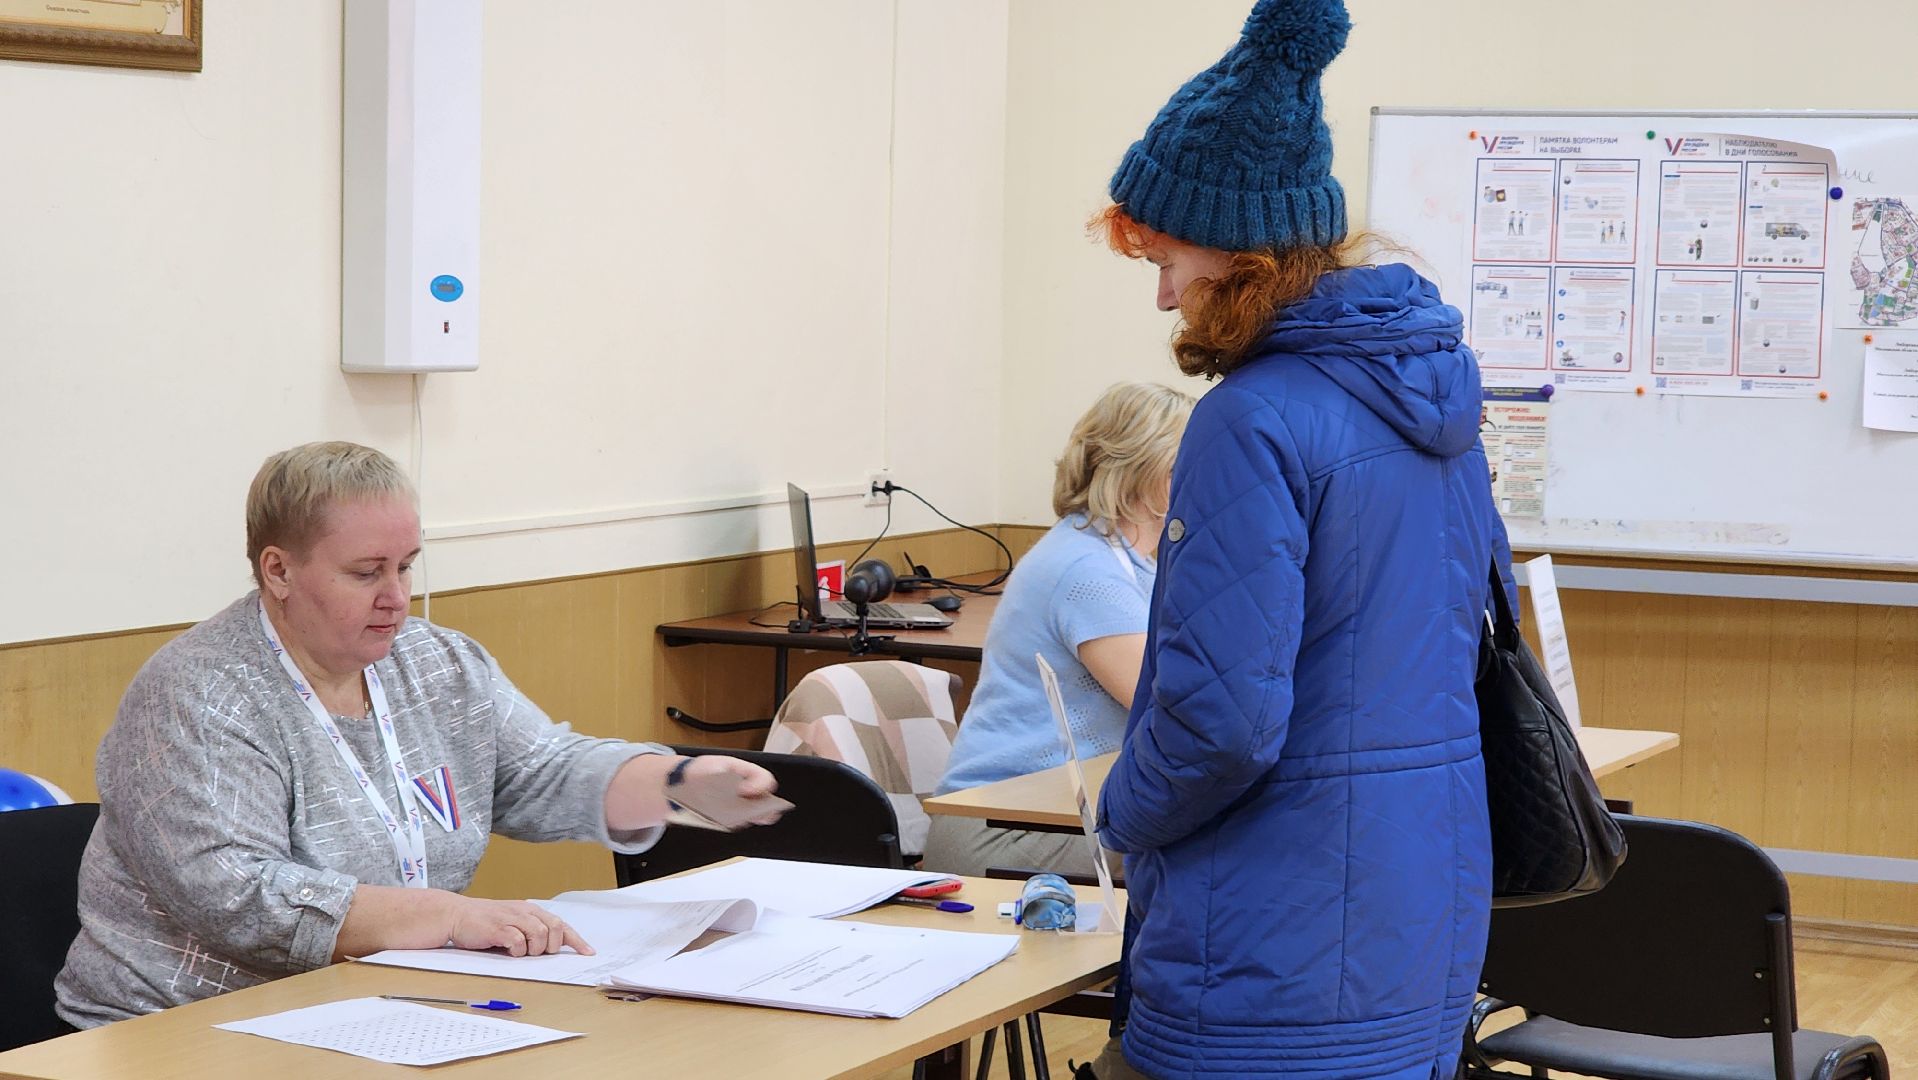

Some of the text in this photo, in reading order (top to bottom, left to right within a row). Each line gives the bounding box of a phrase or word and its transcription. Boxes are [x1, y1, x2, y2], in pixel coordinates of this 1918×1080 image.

[1539, 136, 1618, 145] ПАМЯТКА ВОЛОНТЕРАМ
[1730, 148, 1747, 157] ДНИ
